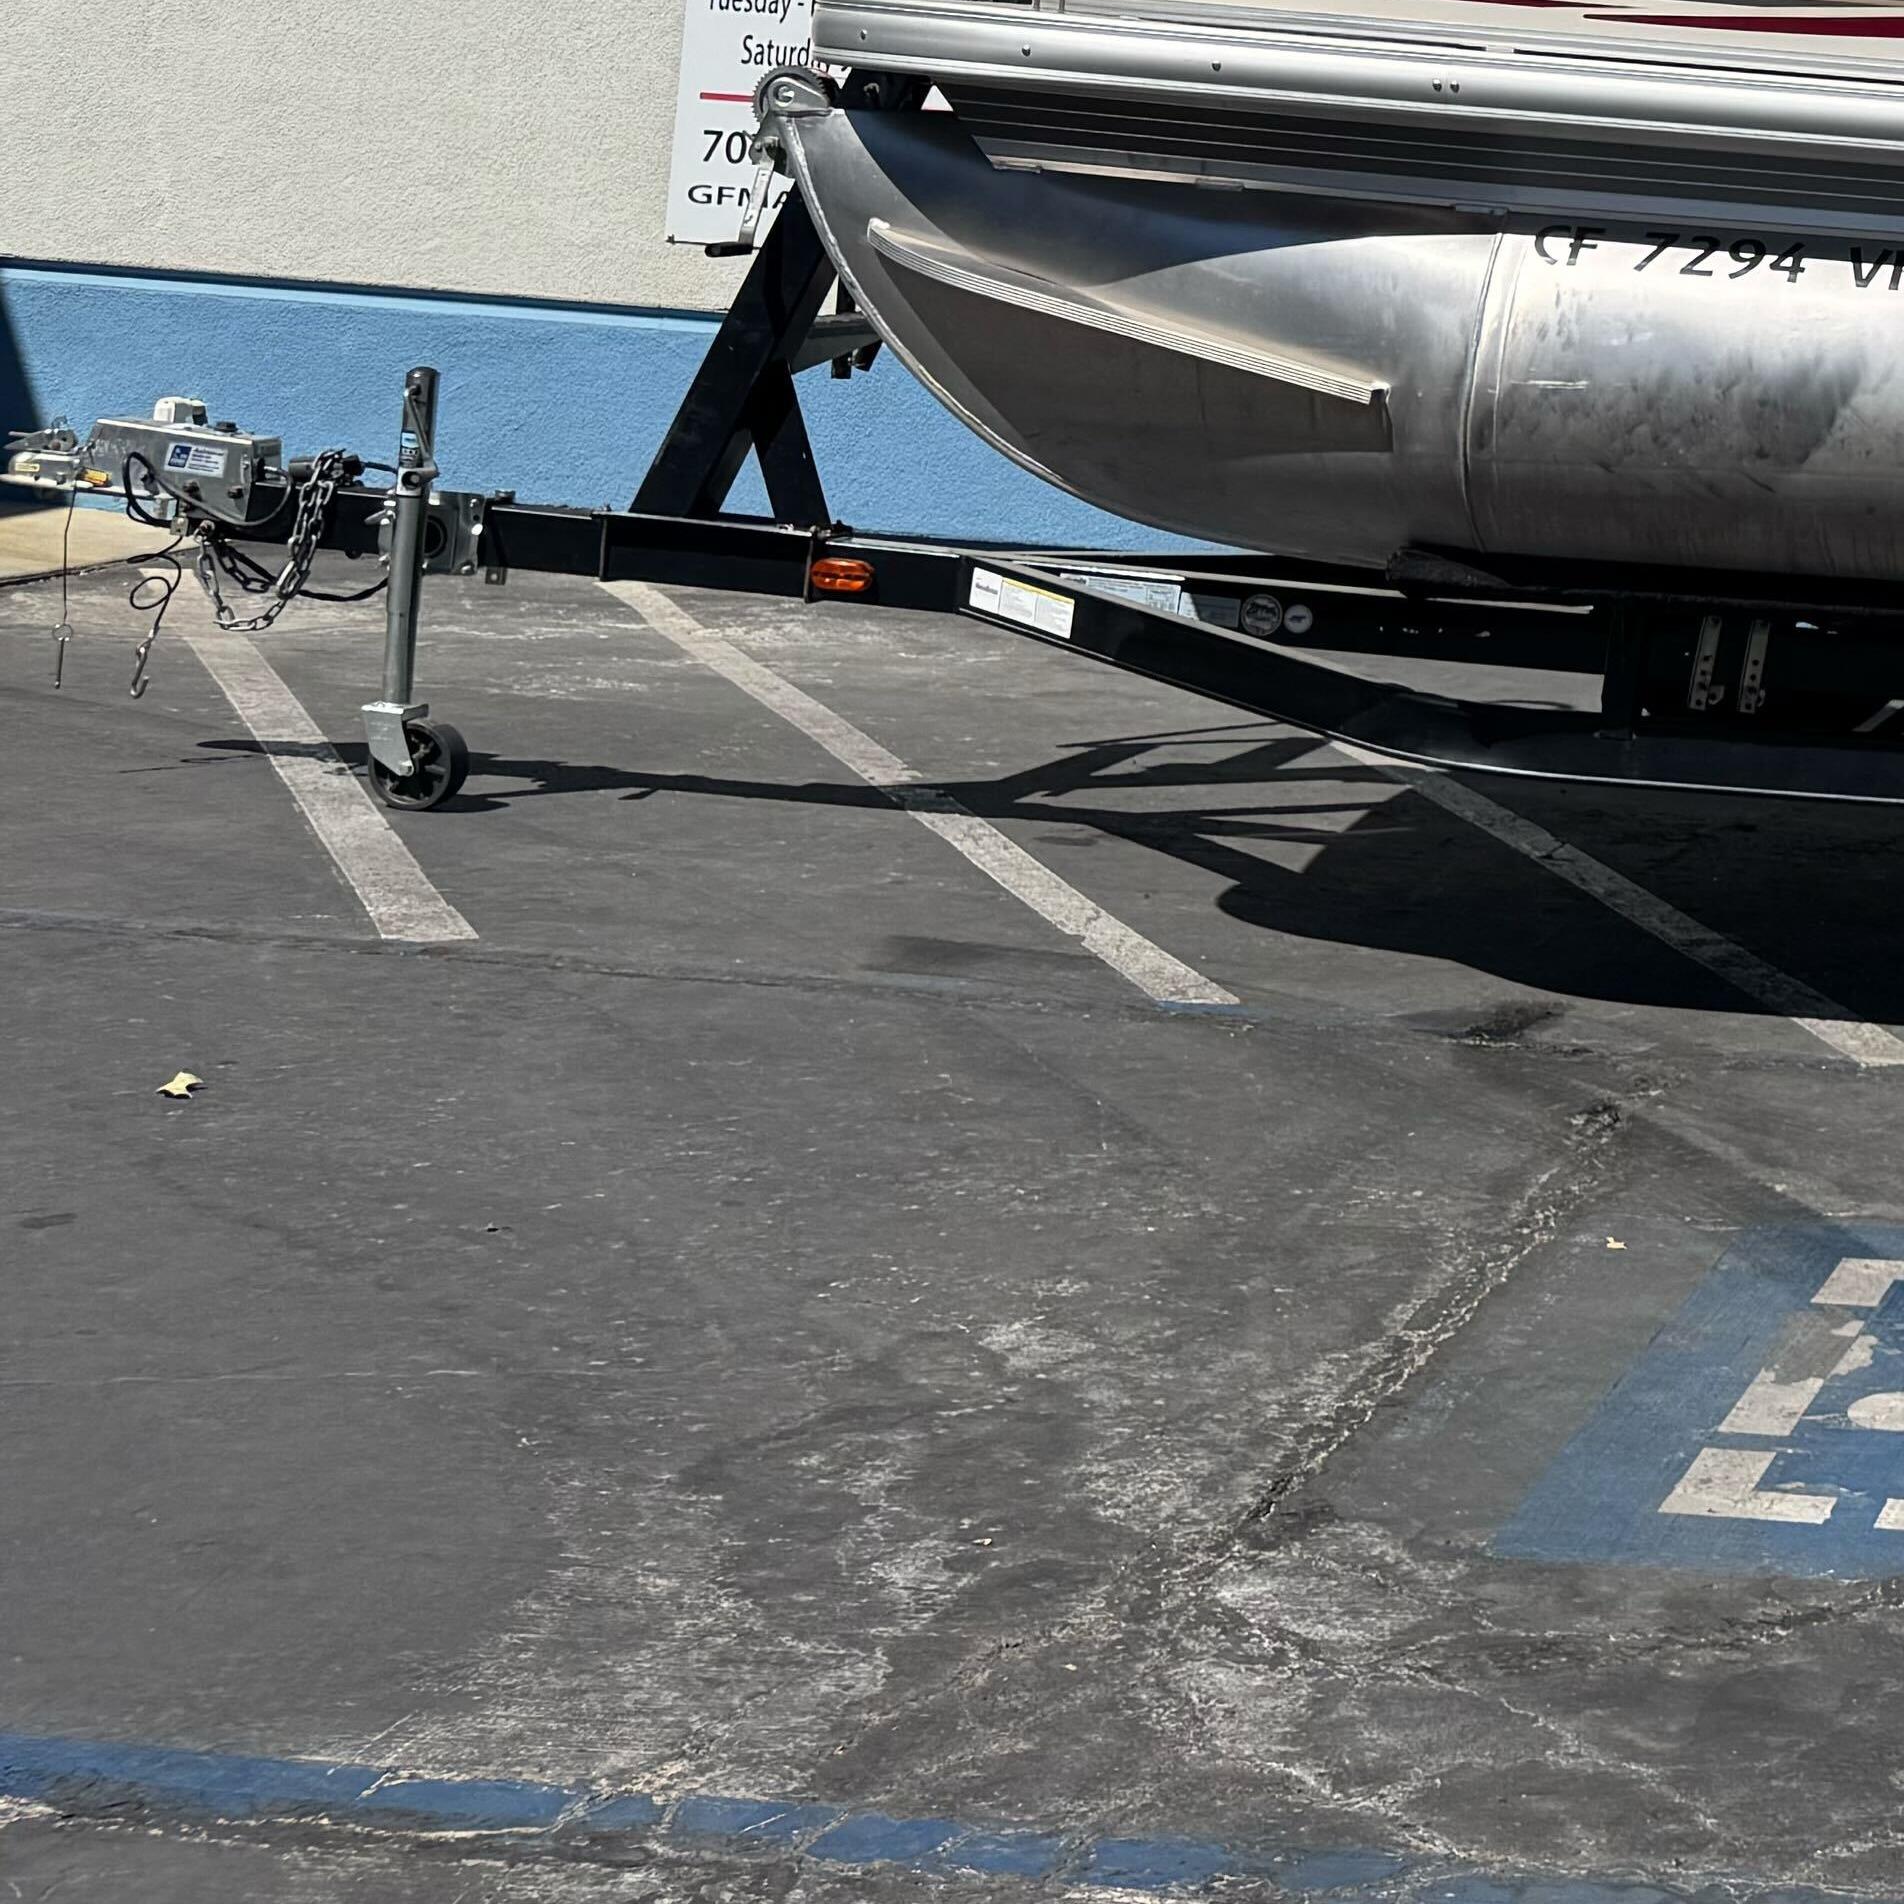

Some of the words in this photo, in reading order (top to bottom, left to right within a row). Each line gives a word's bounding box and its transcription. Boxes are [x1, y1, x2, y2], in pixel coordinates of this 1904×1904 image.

[740, 33, 825, 71] Saturd
[1533, 224, 1607, 266] CF
[1633, 231, 1806, 283] 7294
